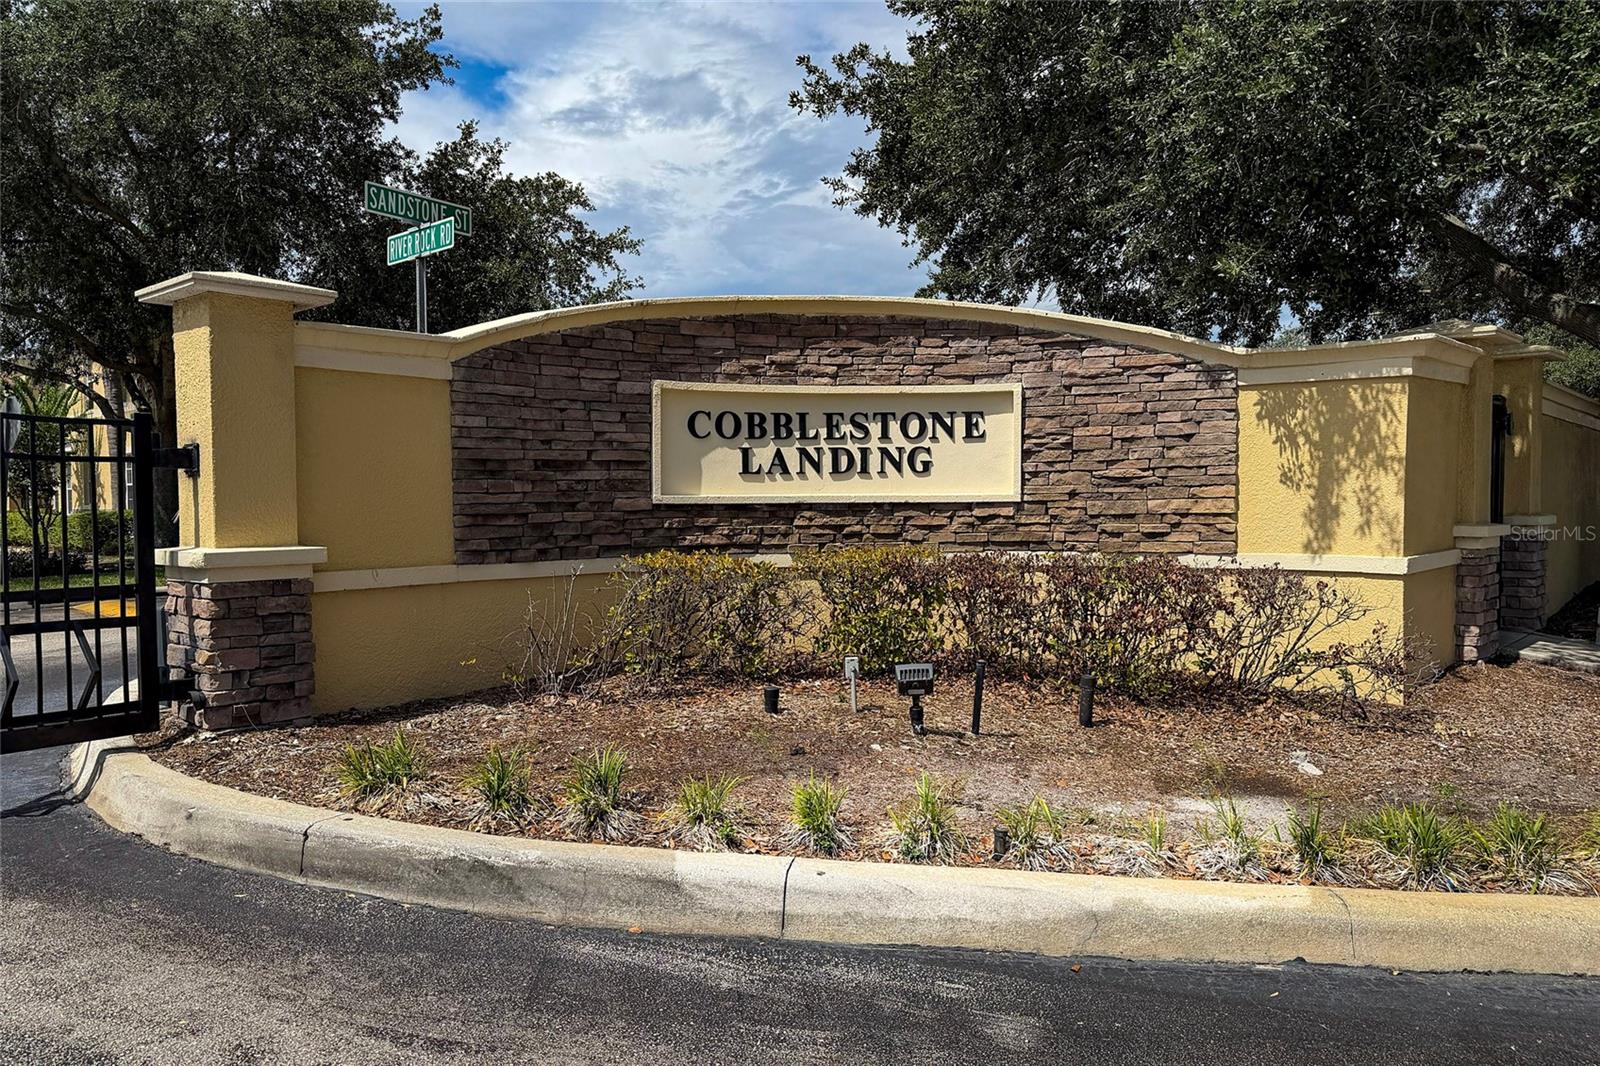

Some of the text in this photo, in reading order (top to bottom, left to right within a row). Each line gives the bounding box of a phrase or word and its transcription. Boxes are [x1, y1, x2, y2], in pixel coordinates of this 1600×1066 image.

[370, 186, 468, 231] SANDSTONE ST
[390, 223, 451, 261] RIVER ROCK RD
[687, 410, 987, 440] COBBLESTONE
[738, 446, 933, 476] LANDING
